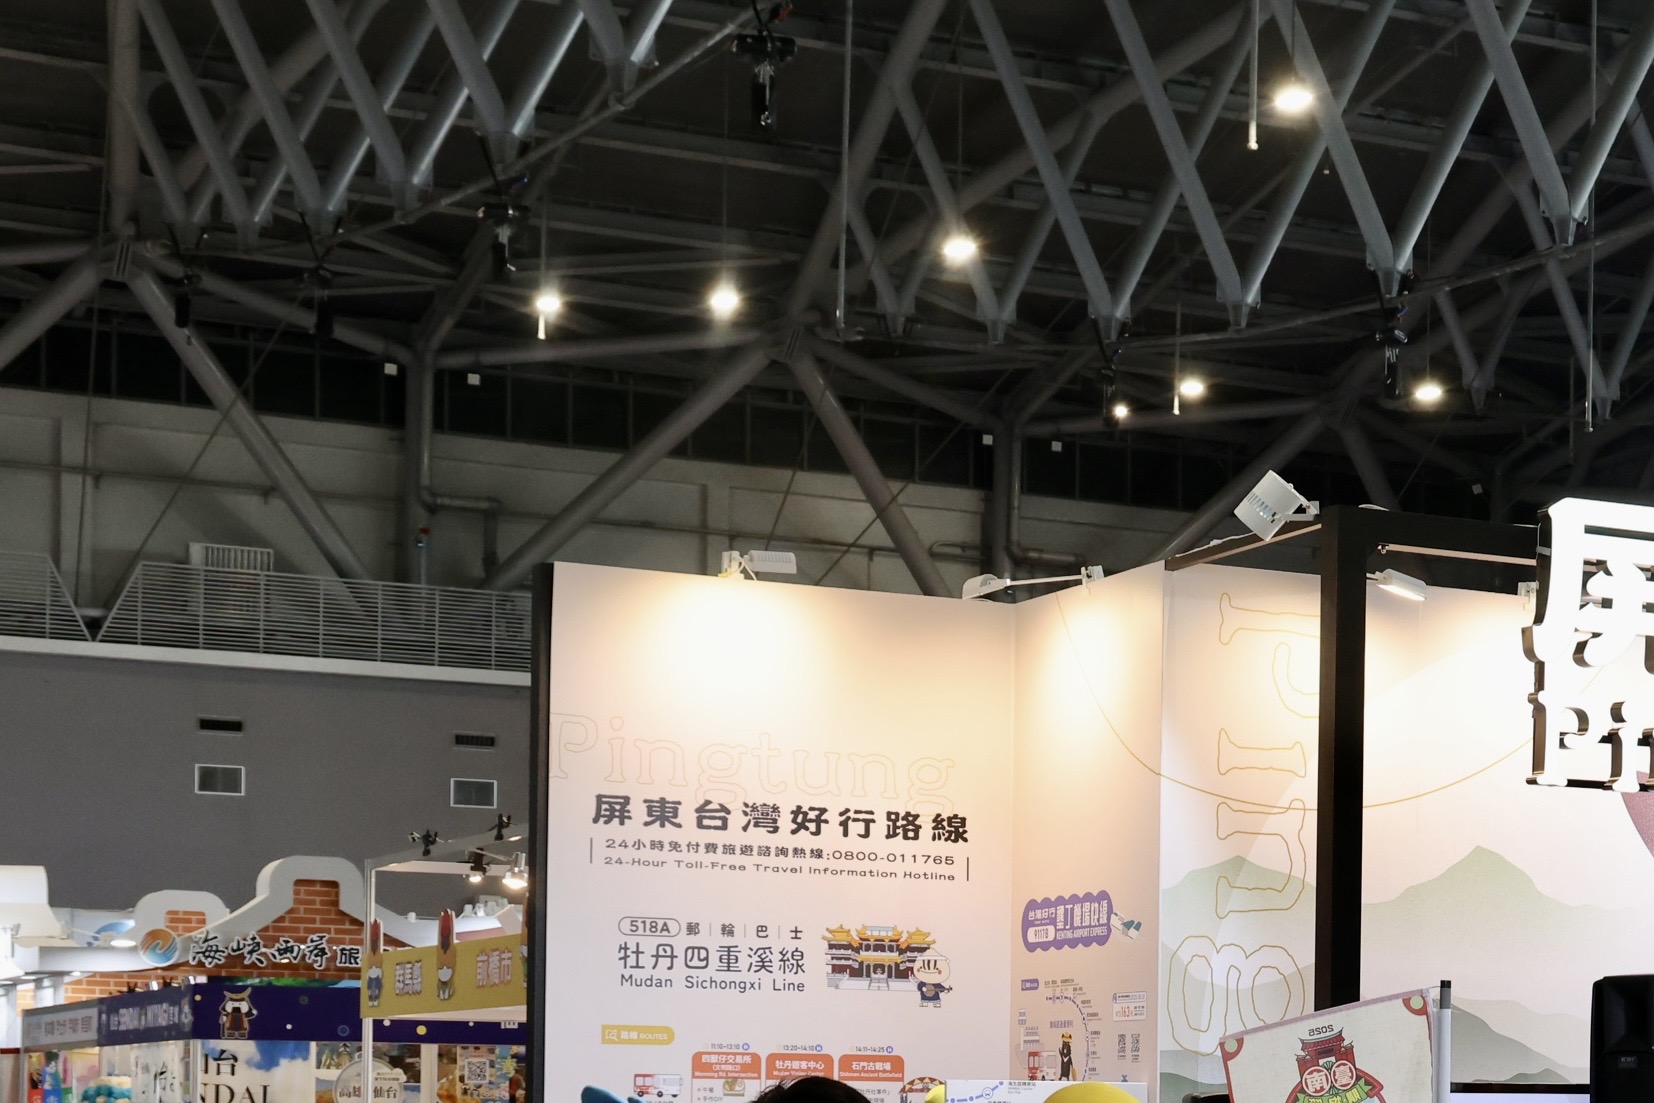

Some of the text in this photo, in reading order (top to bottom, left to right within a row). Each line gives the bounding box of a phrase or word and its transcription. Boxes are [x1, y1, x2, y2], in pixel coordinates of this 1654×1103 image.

[593, 793, 969, 844] 屏東台灣好行路線
[604, 856, 955, 881] 24-Hour Toll-Free Travel Information Hotline
[629, 919, 671, 934] 518A
[1073, 928, 1090, 938] AIRPORT
[1090, 926, 1108, 937] EXPRESS
[618, 941, 806, 974] 牡丹四重溪線
[620, 974, 805, 993] Mudan Sichongxi Line
